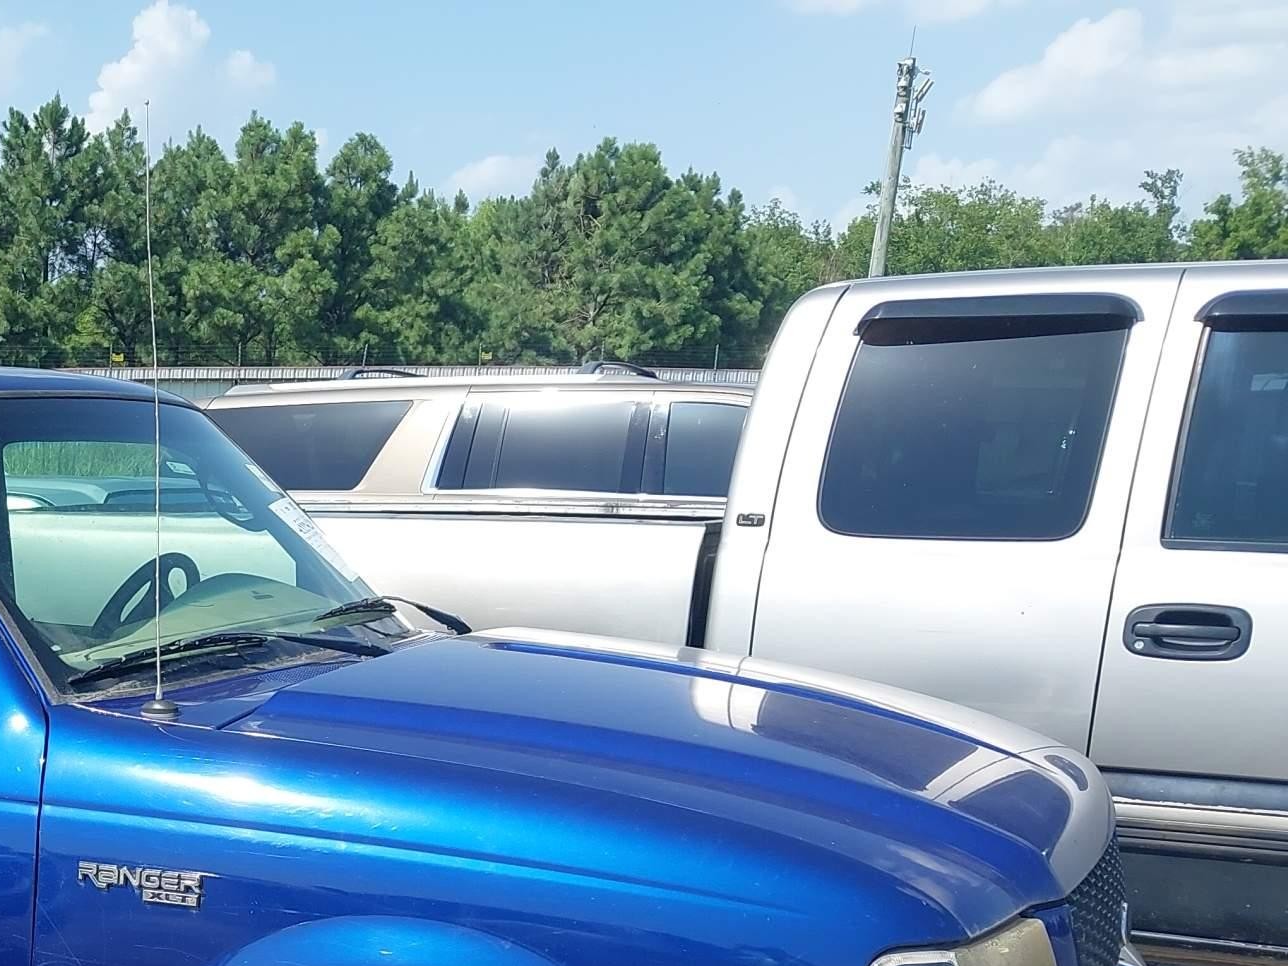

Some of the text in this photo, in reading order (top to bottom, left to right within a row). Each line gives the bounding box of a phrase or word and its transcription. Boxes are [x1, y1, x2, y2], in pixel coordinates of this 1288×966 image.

[737, 514, 765, 526] LT
[78, 860, 202, 893] RANGER
[145, 889, 198, 906] XLT
